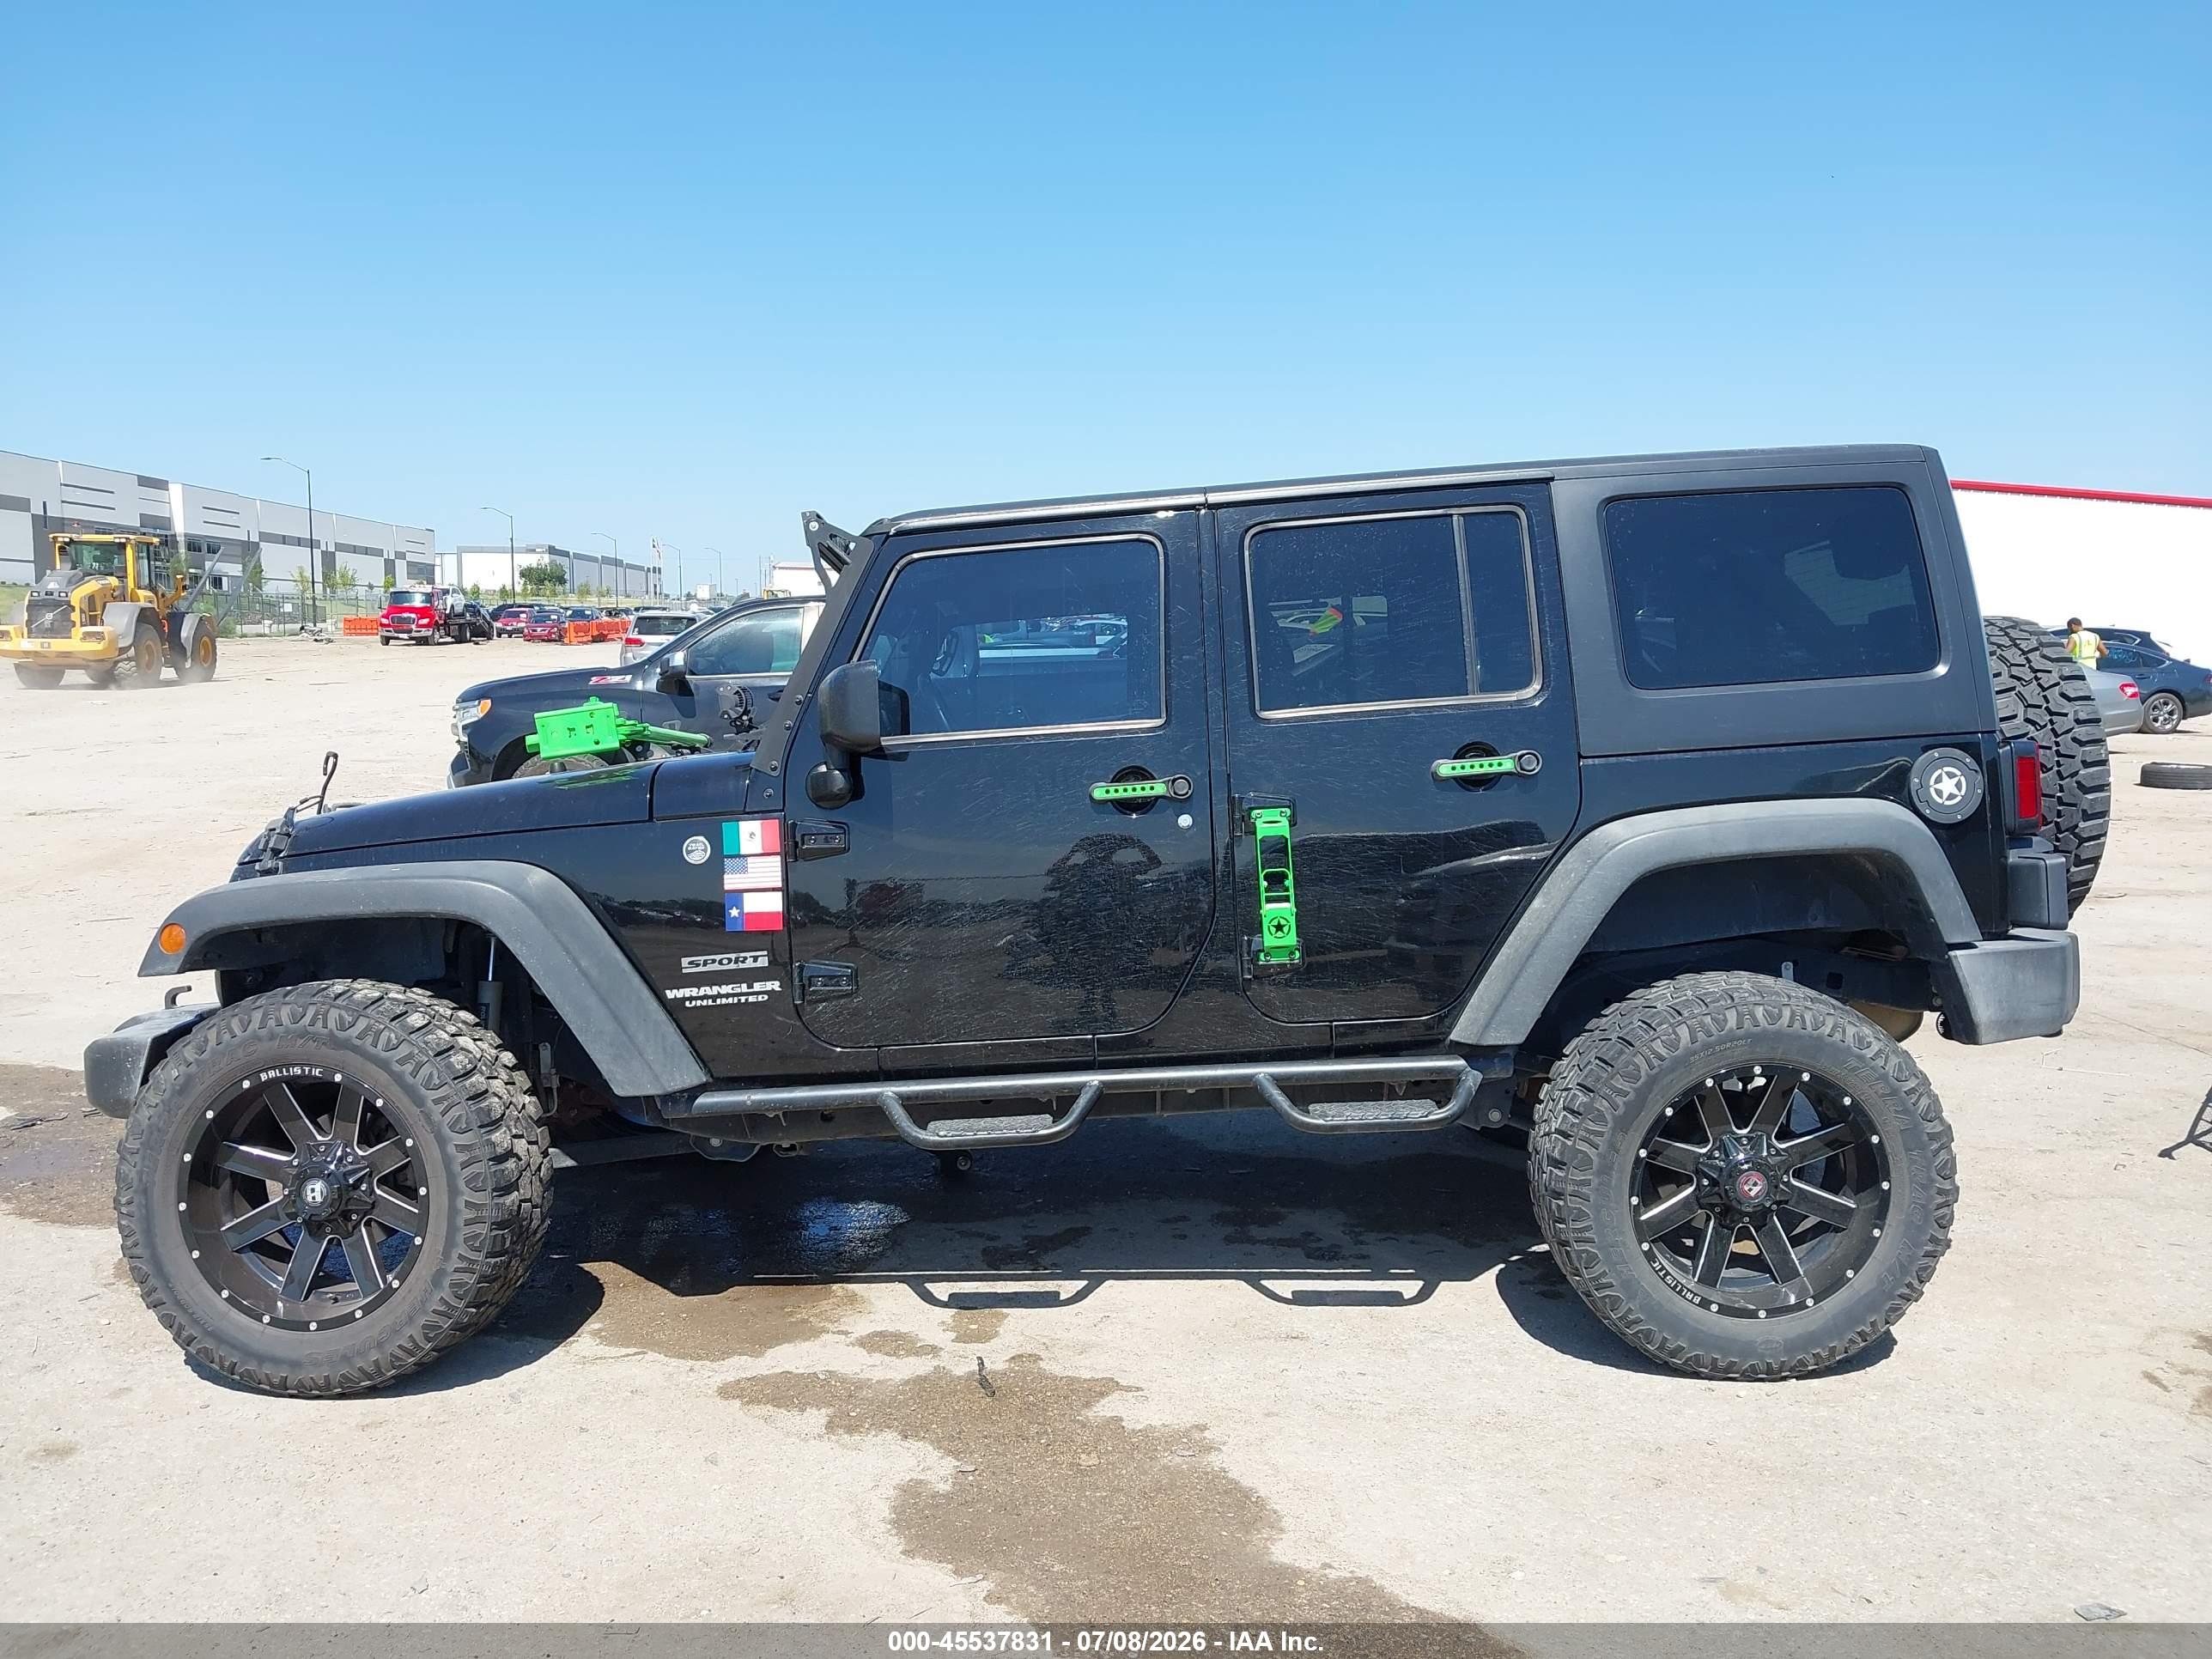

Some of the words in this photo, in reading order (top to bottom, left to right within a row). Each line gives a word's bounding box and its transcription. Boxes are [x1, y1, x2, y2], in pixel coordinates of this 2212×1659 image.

[684, 953, 766, 970] SPORT
[665, 980, 782, 999] WRANGLER
[684, 994, 769, 1007] UNLIMITED
[259, 1066, 324, 1081] BALLISTIC
[1650, 1257, 1701, 1304] BALLISTIC
